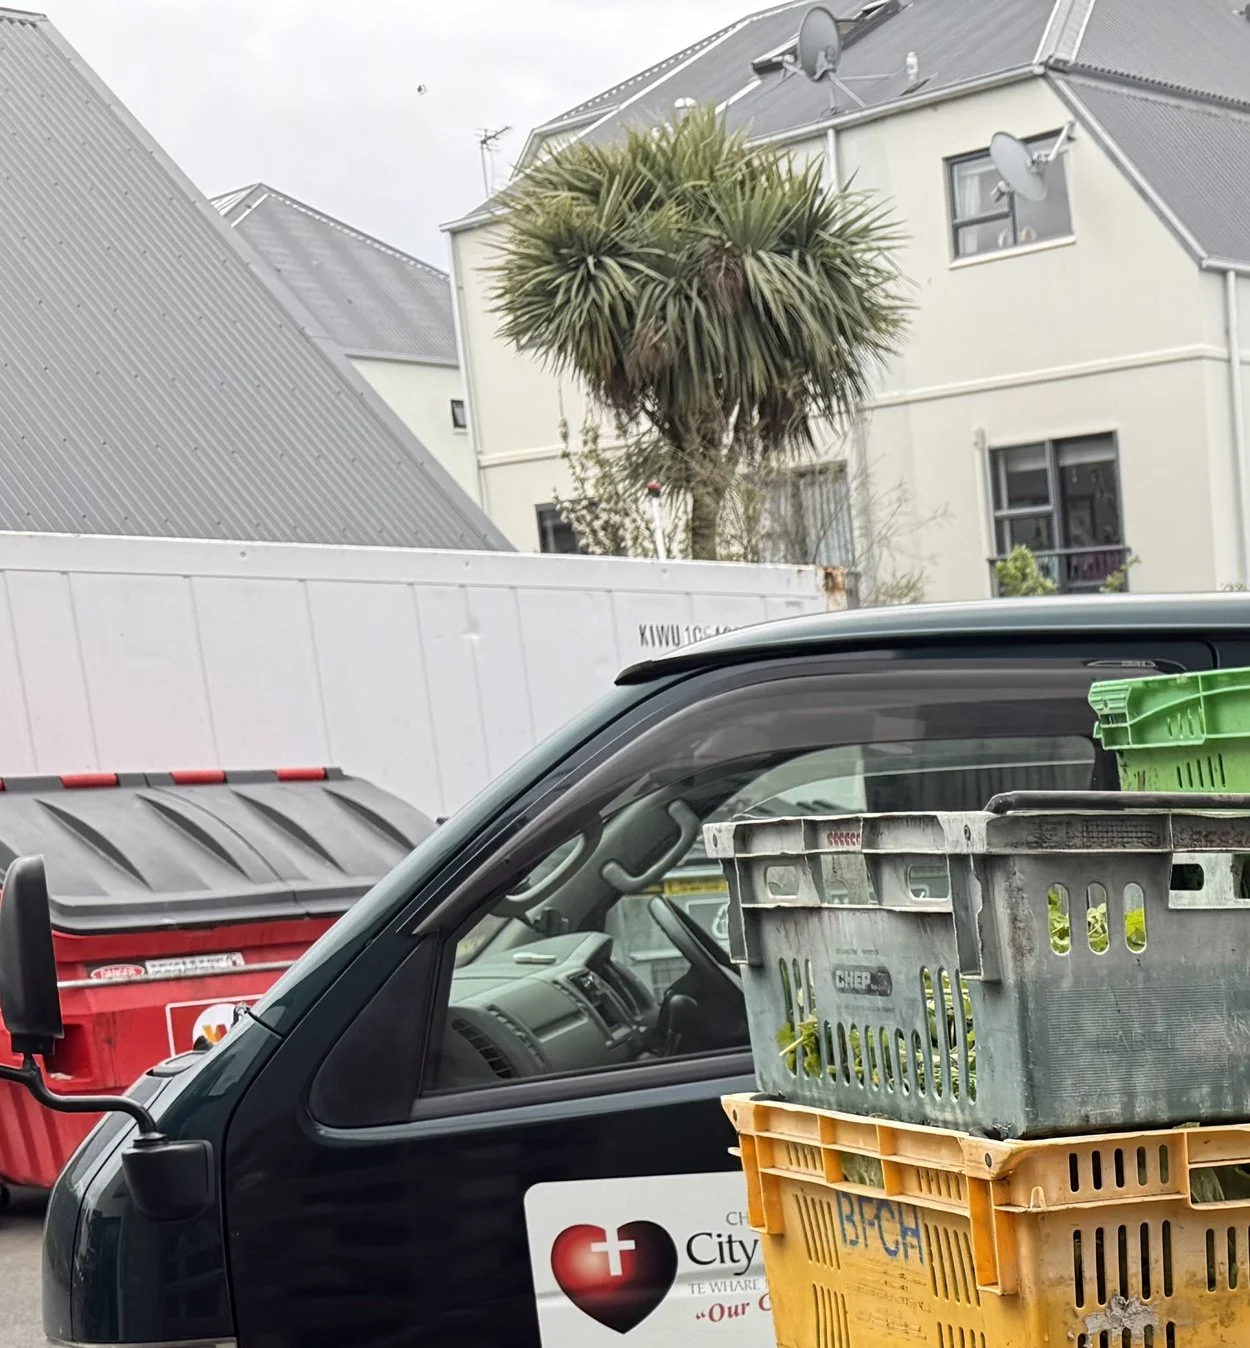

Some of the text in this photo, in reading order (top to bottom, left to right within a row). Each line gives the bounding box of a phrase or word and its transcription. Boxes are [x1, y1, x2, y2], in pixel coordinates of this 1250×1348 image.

[639, 623, 681, 647] KIWU
[835, 969, 871, 990] CHEP
[836, 1190, 925, 1265] BFCH
[686, 1231, 760, 1276] City
[688, 1282, 706, 1295] TE
[709, 1279, 760, 1293] WHARE
